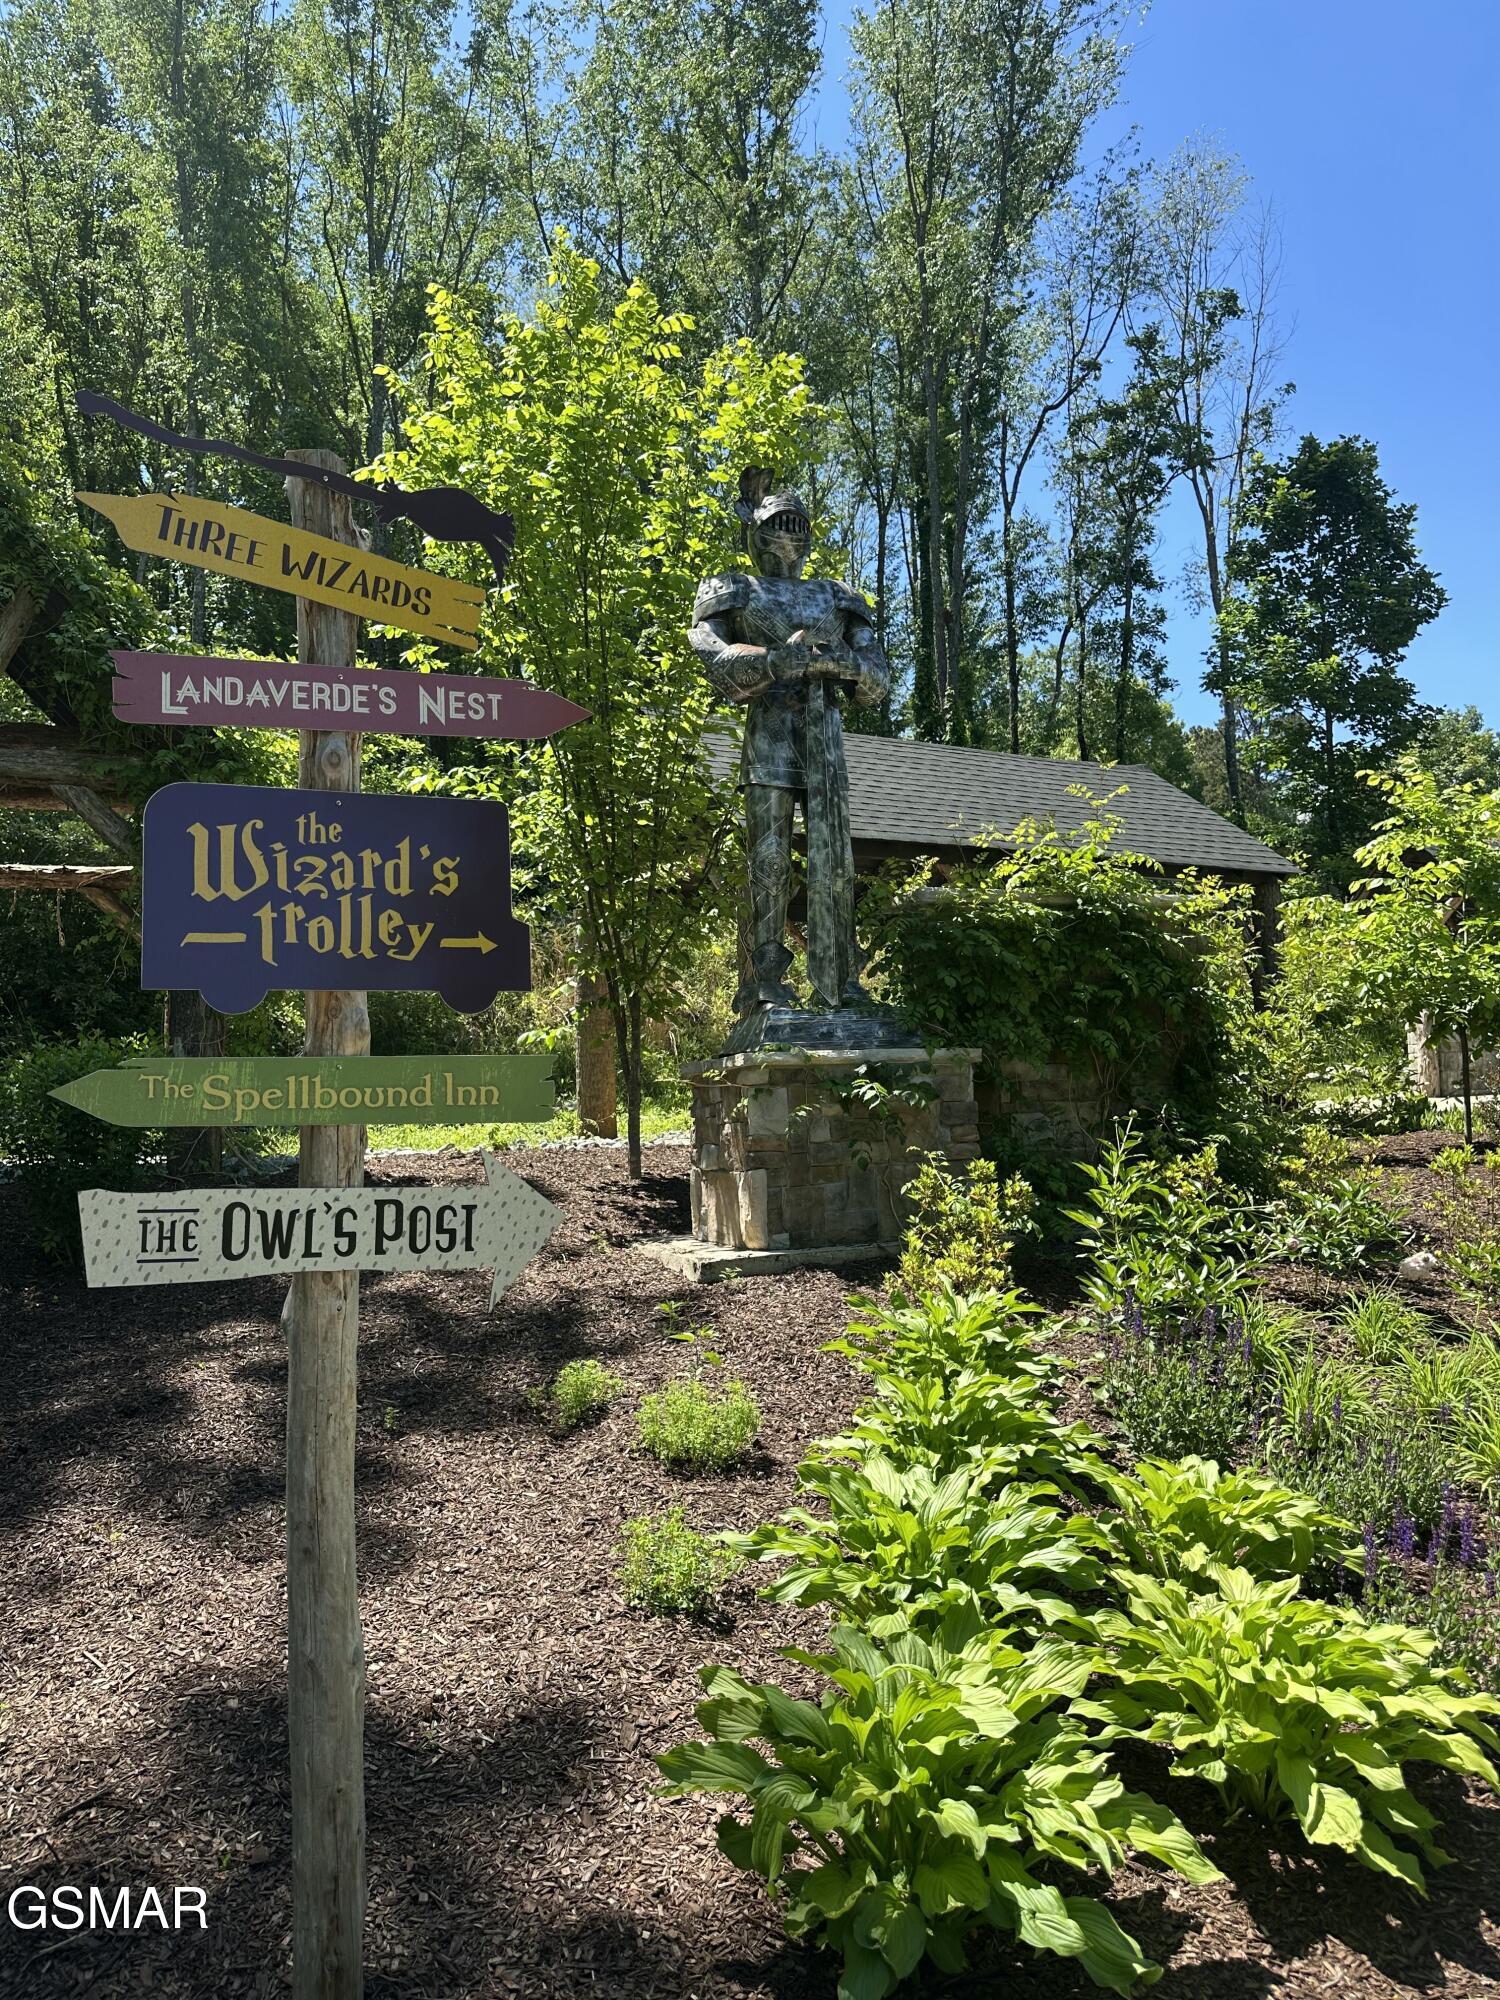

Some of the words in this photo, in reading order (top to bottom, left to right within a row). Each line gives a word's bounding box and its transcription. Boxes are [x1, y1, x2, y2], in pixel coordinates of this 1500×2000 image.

[156, 503, 268, 569] THREE
[281, 543, 431, 616] WIZARDS
[161, 671, 397, 716] LANDAVERDE'S
[418, 684, 503, 726] NEST
[296, 811, 343, 845] the
[186, 819, 460, 902] Wizard's
[253, 893, 434, 967] trolley
[138, 1073, 194, 1099] The
[202, 1073, 435, 1122] Spellbound
[443, 1072, 500, 1106] Inn
[138, 1218, 200, 1253] THE
[221, 1201, 358, 1261] OWL'S
[374, 1199, 478, 1255] POST
